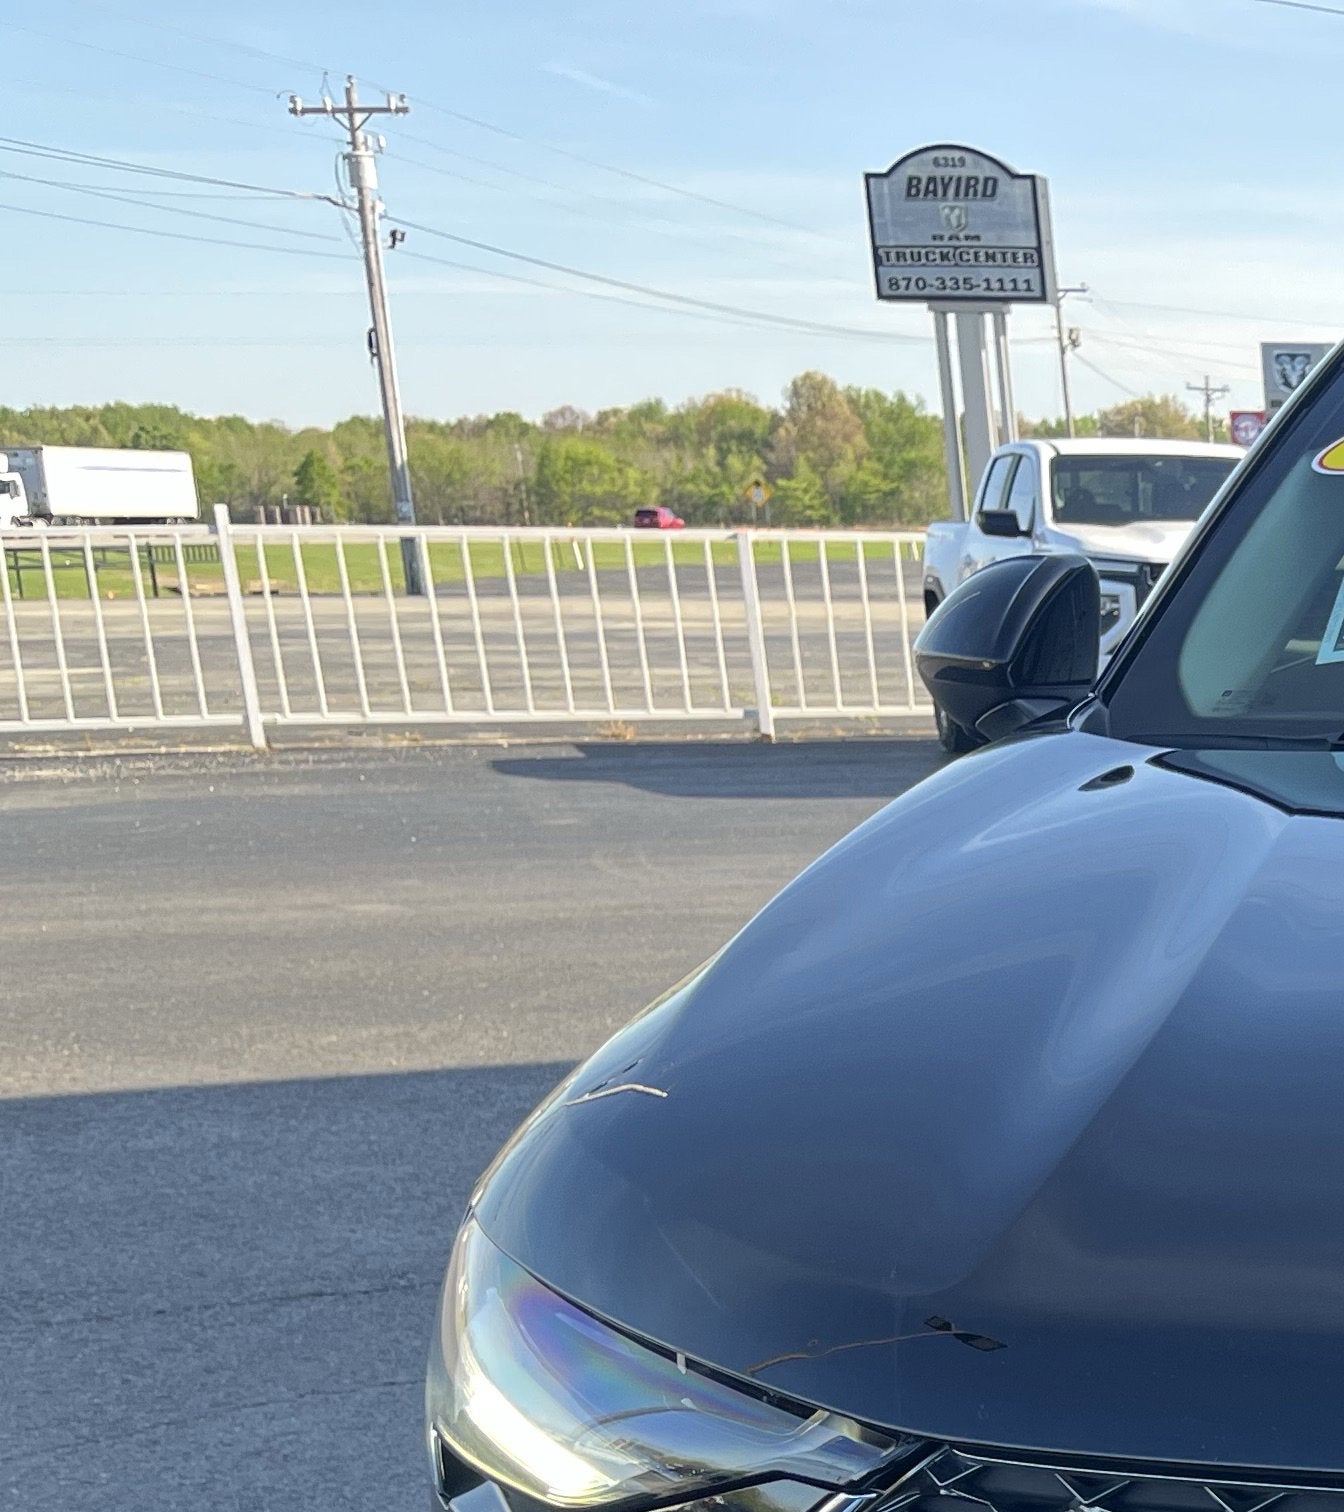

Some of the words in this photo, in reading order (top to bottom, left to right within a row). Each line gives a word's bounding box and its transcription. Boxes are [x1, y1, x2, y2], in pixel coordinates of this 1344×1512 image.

[932, 156, 966, 168] 6319
[906, 175, 998, 198] BAYIRD
[883, 250, 954, 263] TRUCK
[959, 251, 1035, 264] CENTER
[888, 276, 1035, 292] 870-335-1111
